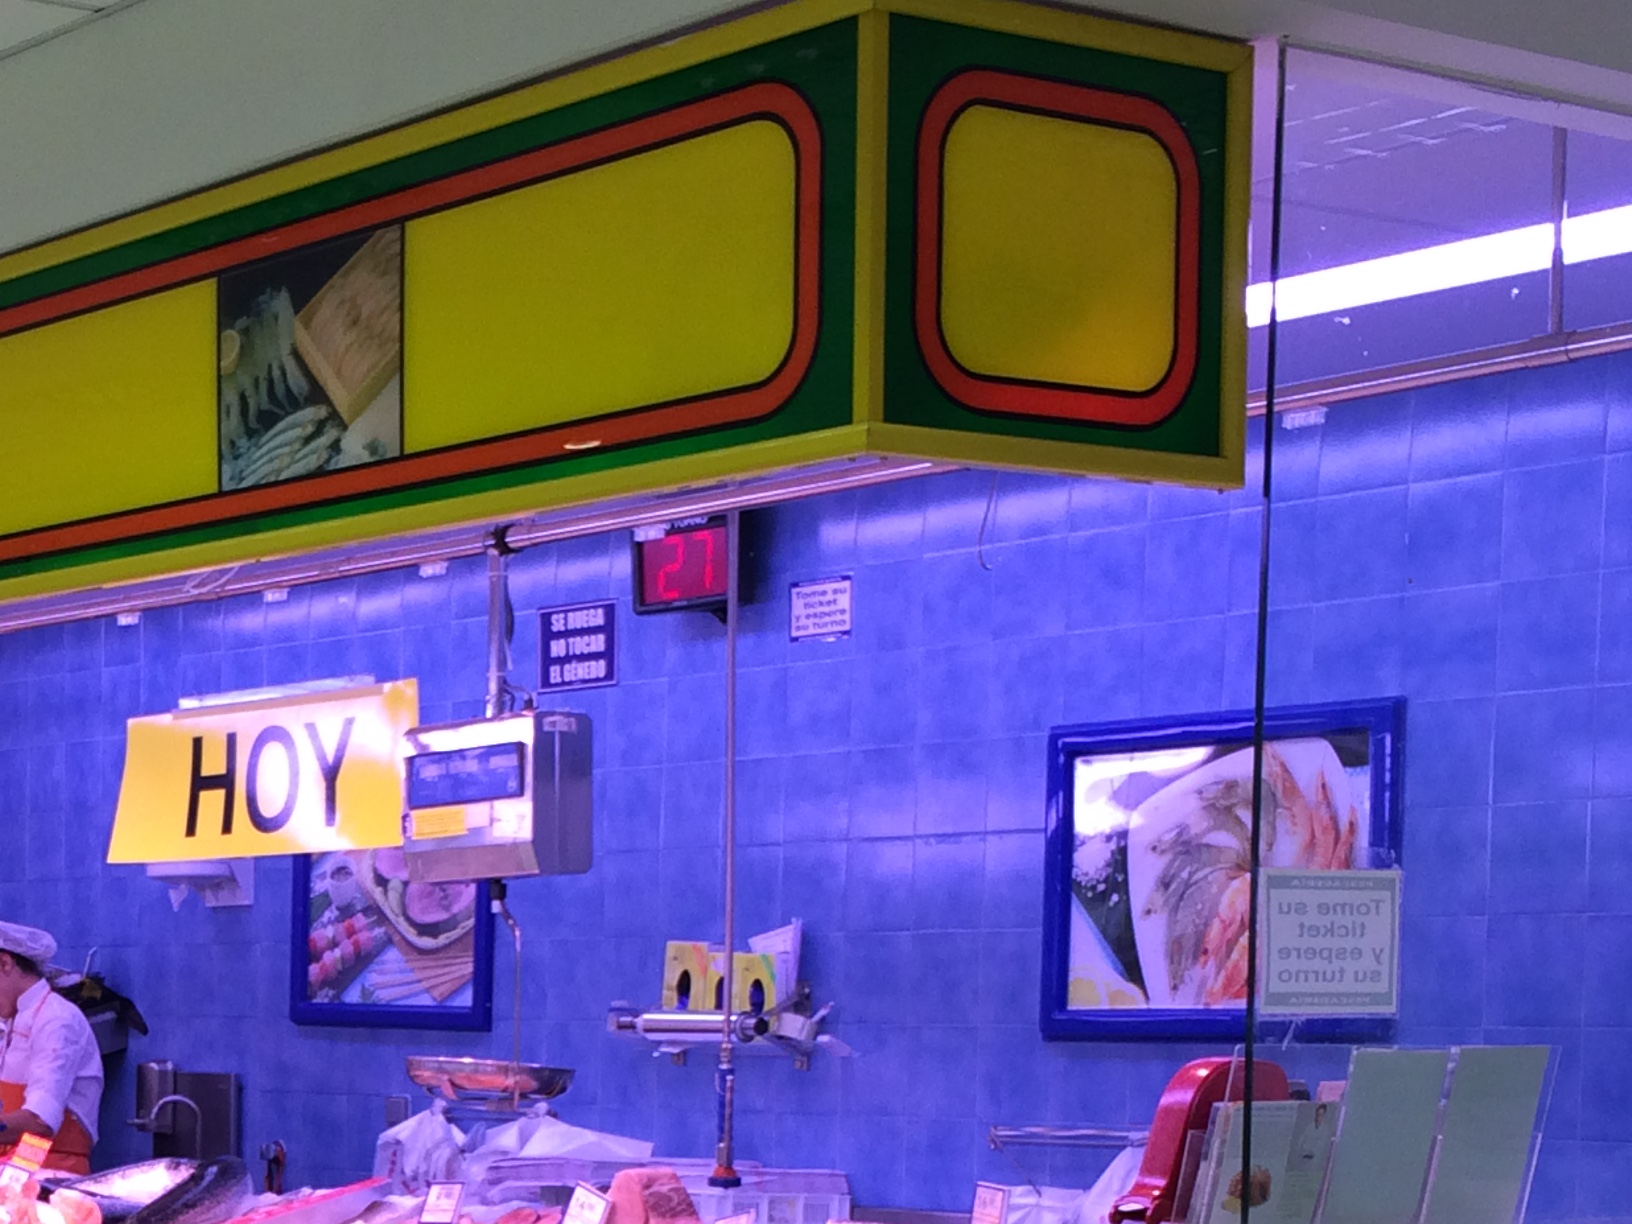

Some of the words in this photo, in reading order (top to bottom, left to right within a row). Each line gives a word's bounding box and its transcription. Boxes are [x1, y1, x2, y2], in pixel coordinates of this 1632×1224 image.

[657, 530, 714, 600] 27
[550, 613, 565, 632] SE
[567, 608, 604, 630] RUEGA
[550, 639, 566, 658] NO
[568, 634, 605, 656] TOCAR
[549, 665, 562, 684] EL
[563, 659, 606, 682] GÉNERO
[185, 717, 356, 838] HOY
